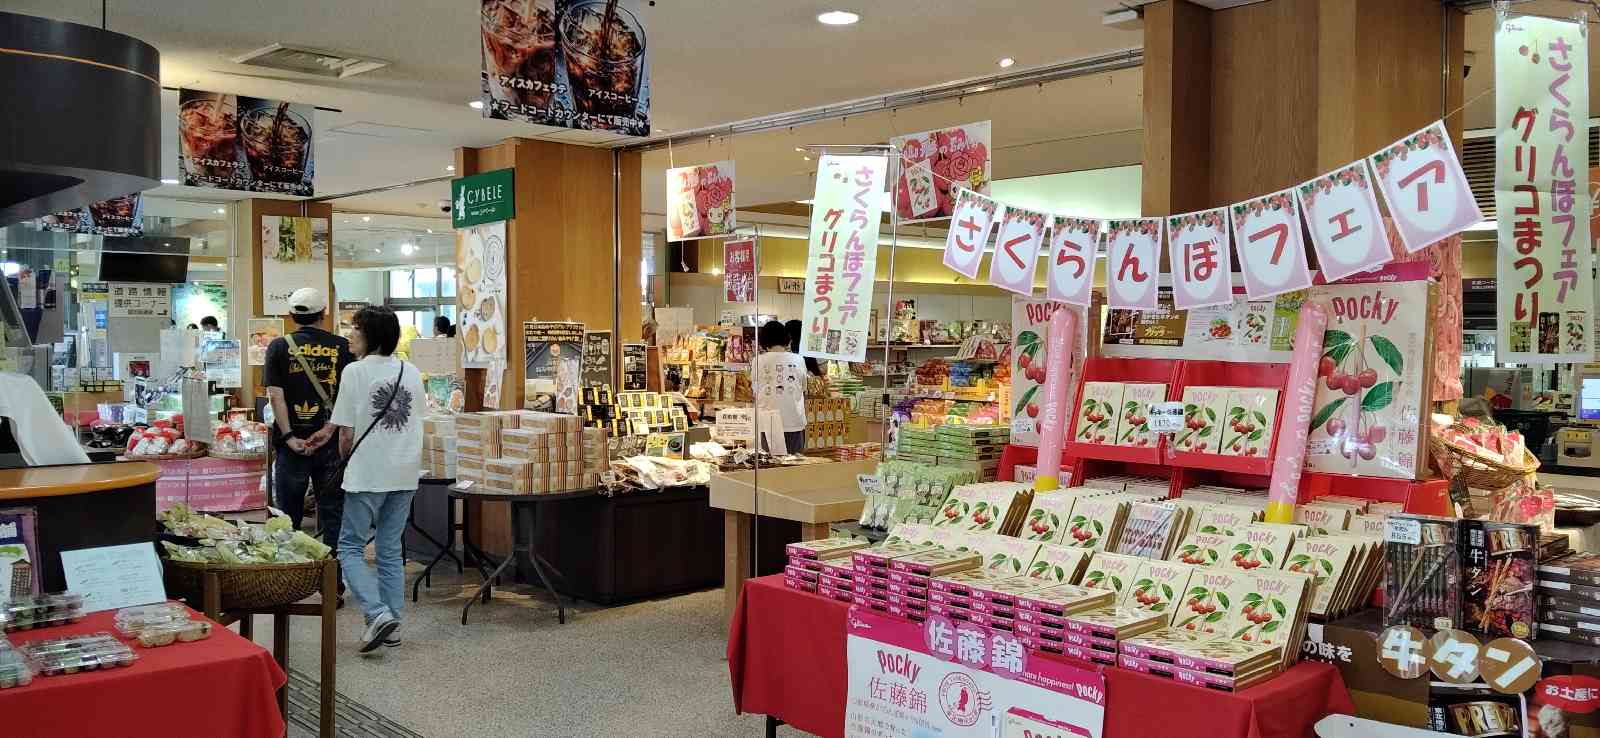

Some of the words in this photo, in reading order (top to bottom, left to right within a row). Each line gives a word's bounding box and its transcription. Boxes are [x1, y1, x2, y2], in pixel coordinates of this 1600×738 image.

[500, 76, 567, 94] アイスカフェラテ
[588, 88, 640, 104] アイスコーヒー
[193, 159, 249, 169] アイスカフェラテ
[263, 165, 304, 174] アイスコーヒー
[467, 184, 503, 204] CYBELE
[1511, 106, 1544, 329] グリコまつり
[812, 208, 844, 336] グリコまつり
[929, 619, 1023, 674] 佐藤錦
[1303, 640, 1353, 662] の味を
[1382, 628, 1536, 688] 牛タン
[1023, 671, 1037, 681] hare
[869, 676, 928, 714] 佐藤錦
[1545, 684, 1599, 701] お土産に
